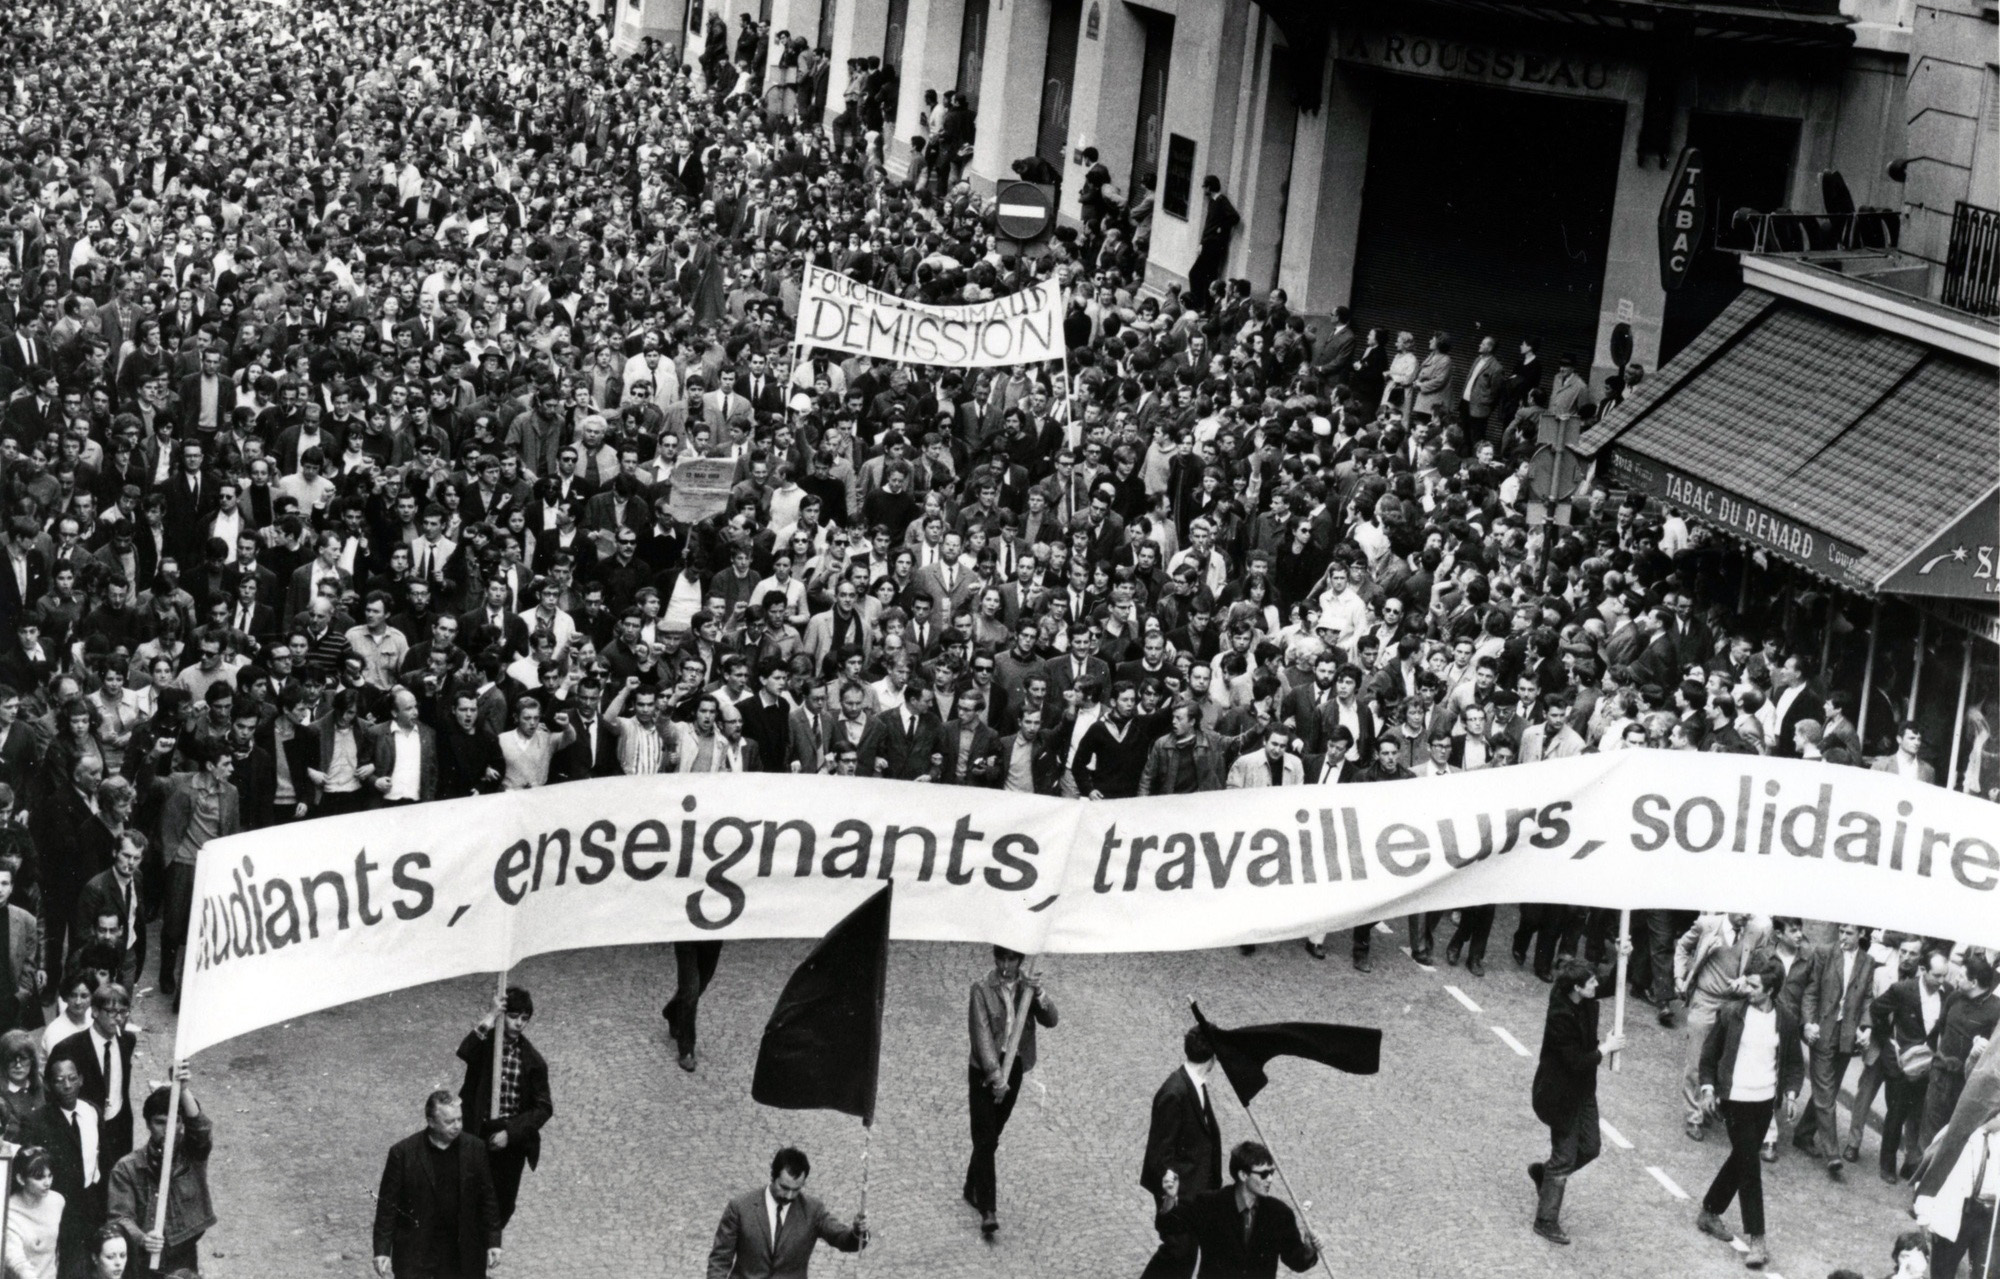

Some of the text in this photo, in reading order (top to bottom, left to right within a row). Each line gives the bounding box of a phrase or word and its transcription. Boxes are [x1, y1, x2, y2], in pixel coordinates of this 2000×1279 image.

[1385, 35, 1607, 90] ROUSSEAU
[1670, 168, 1700, 272] TABAC
[805, 296, 1053, 363] DEMISSION
[1666, 473, 1714, 515] TABAC
[1719, 497, 1741, 526] DU
[1745, 508, 1813, 558] RENARD
[1972, 545, 1999, 579] S
[494, 794, 1060, 930] enseignants,
[1093, 800, 1606, 894] travailleurs,
